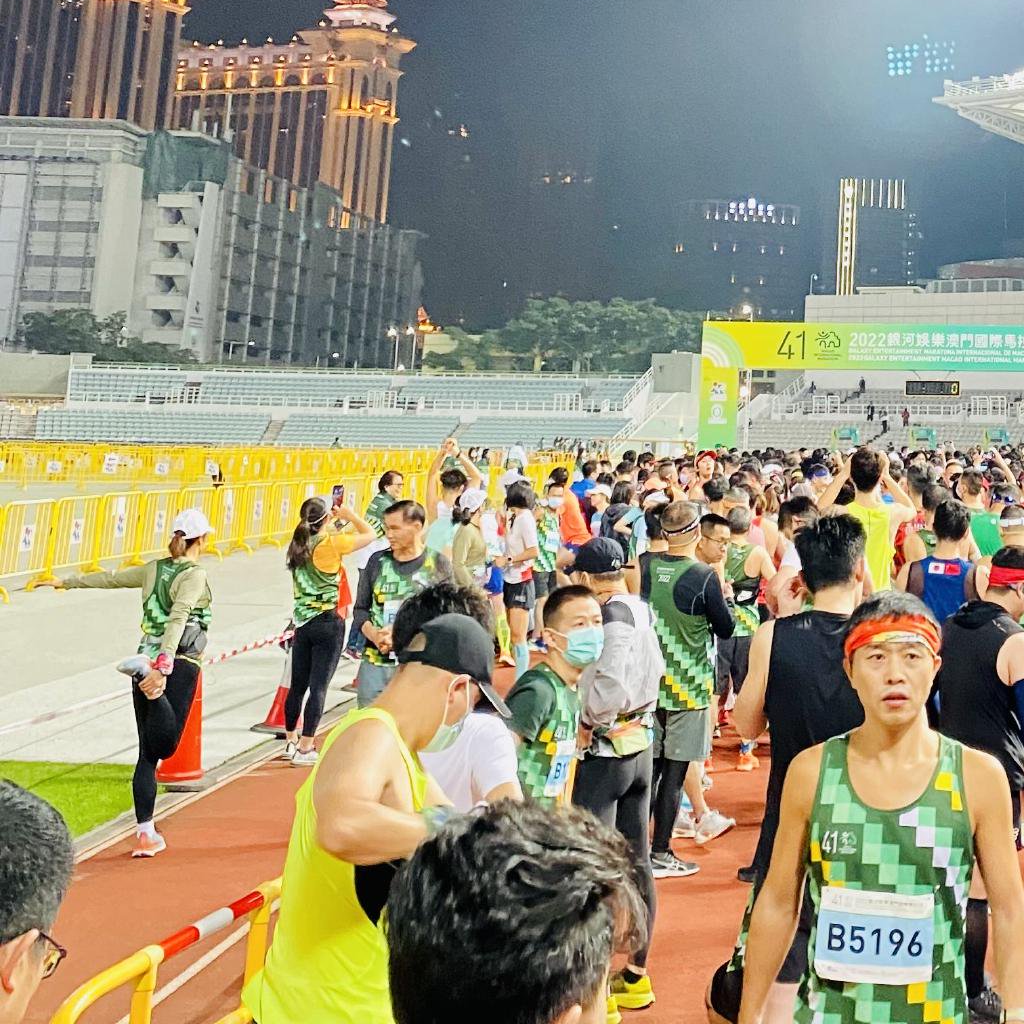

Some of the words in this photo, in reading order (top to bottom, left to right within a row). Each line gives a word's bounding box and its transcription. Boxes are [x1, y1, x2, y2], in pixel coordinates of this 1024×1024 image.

[777, 331, 805, 360] 41
[822, 830, 839, 854] 41
[827, 923, 923, 957] B5196
